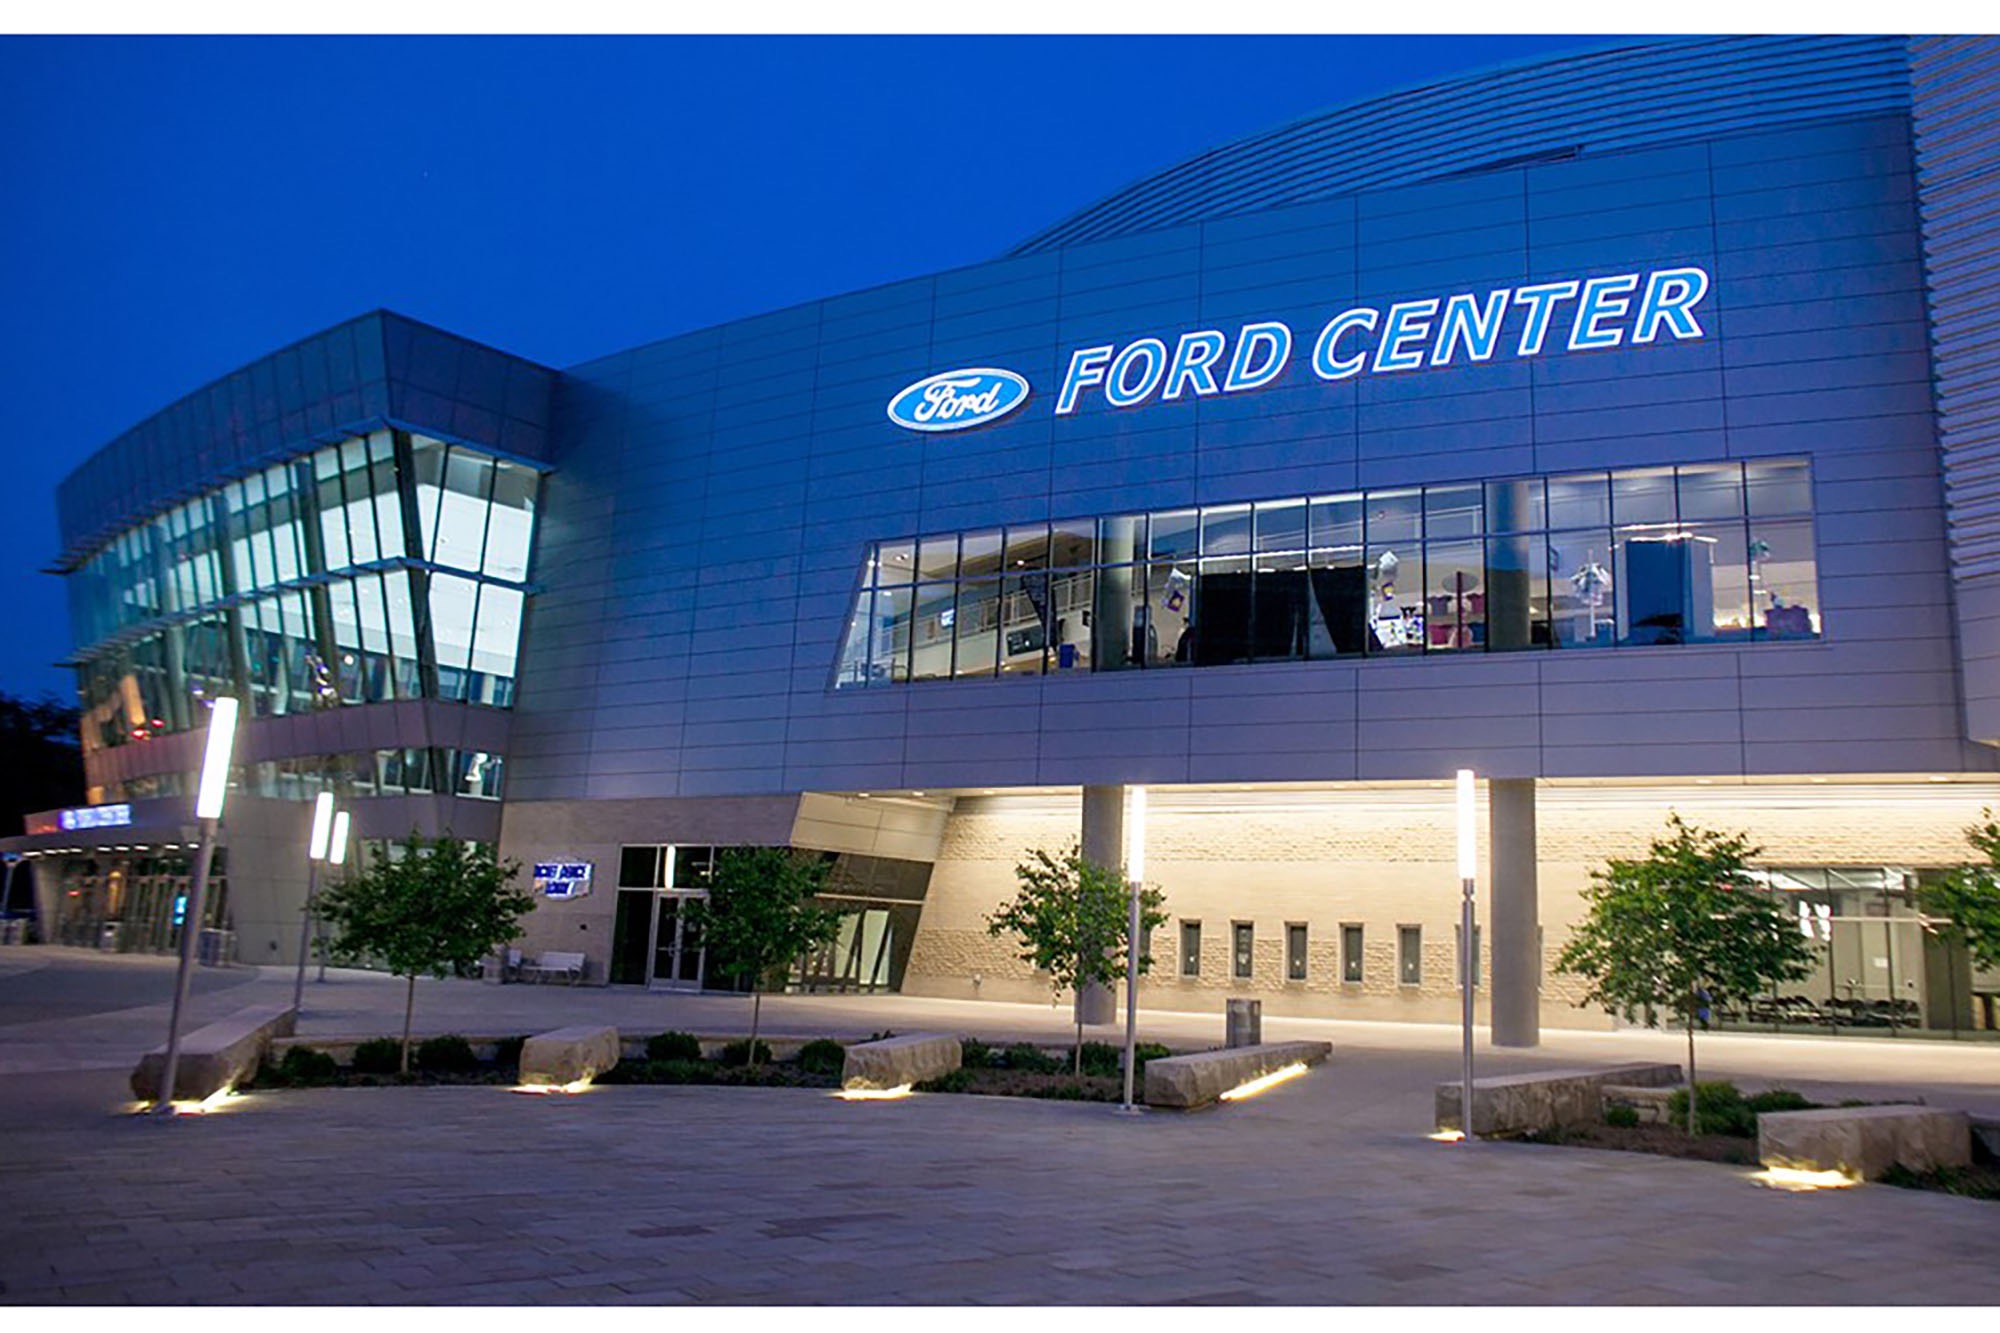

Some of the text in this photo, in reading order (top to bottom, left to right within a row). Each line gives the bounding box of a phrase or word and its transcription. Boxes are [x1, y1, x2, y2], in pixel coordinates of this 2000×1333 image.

[1054, 267, 1709, 415] FORD CENTER
[914, 377, 1003, 421] Ford
